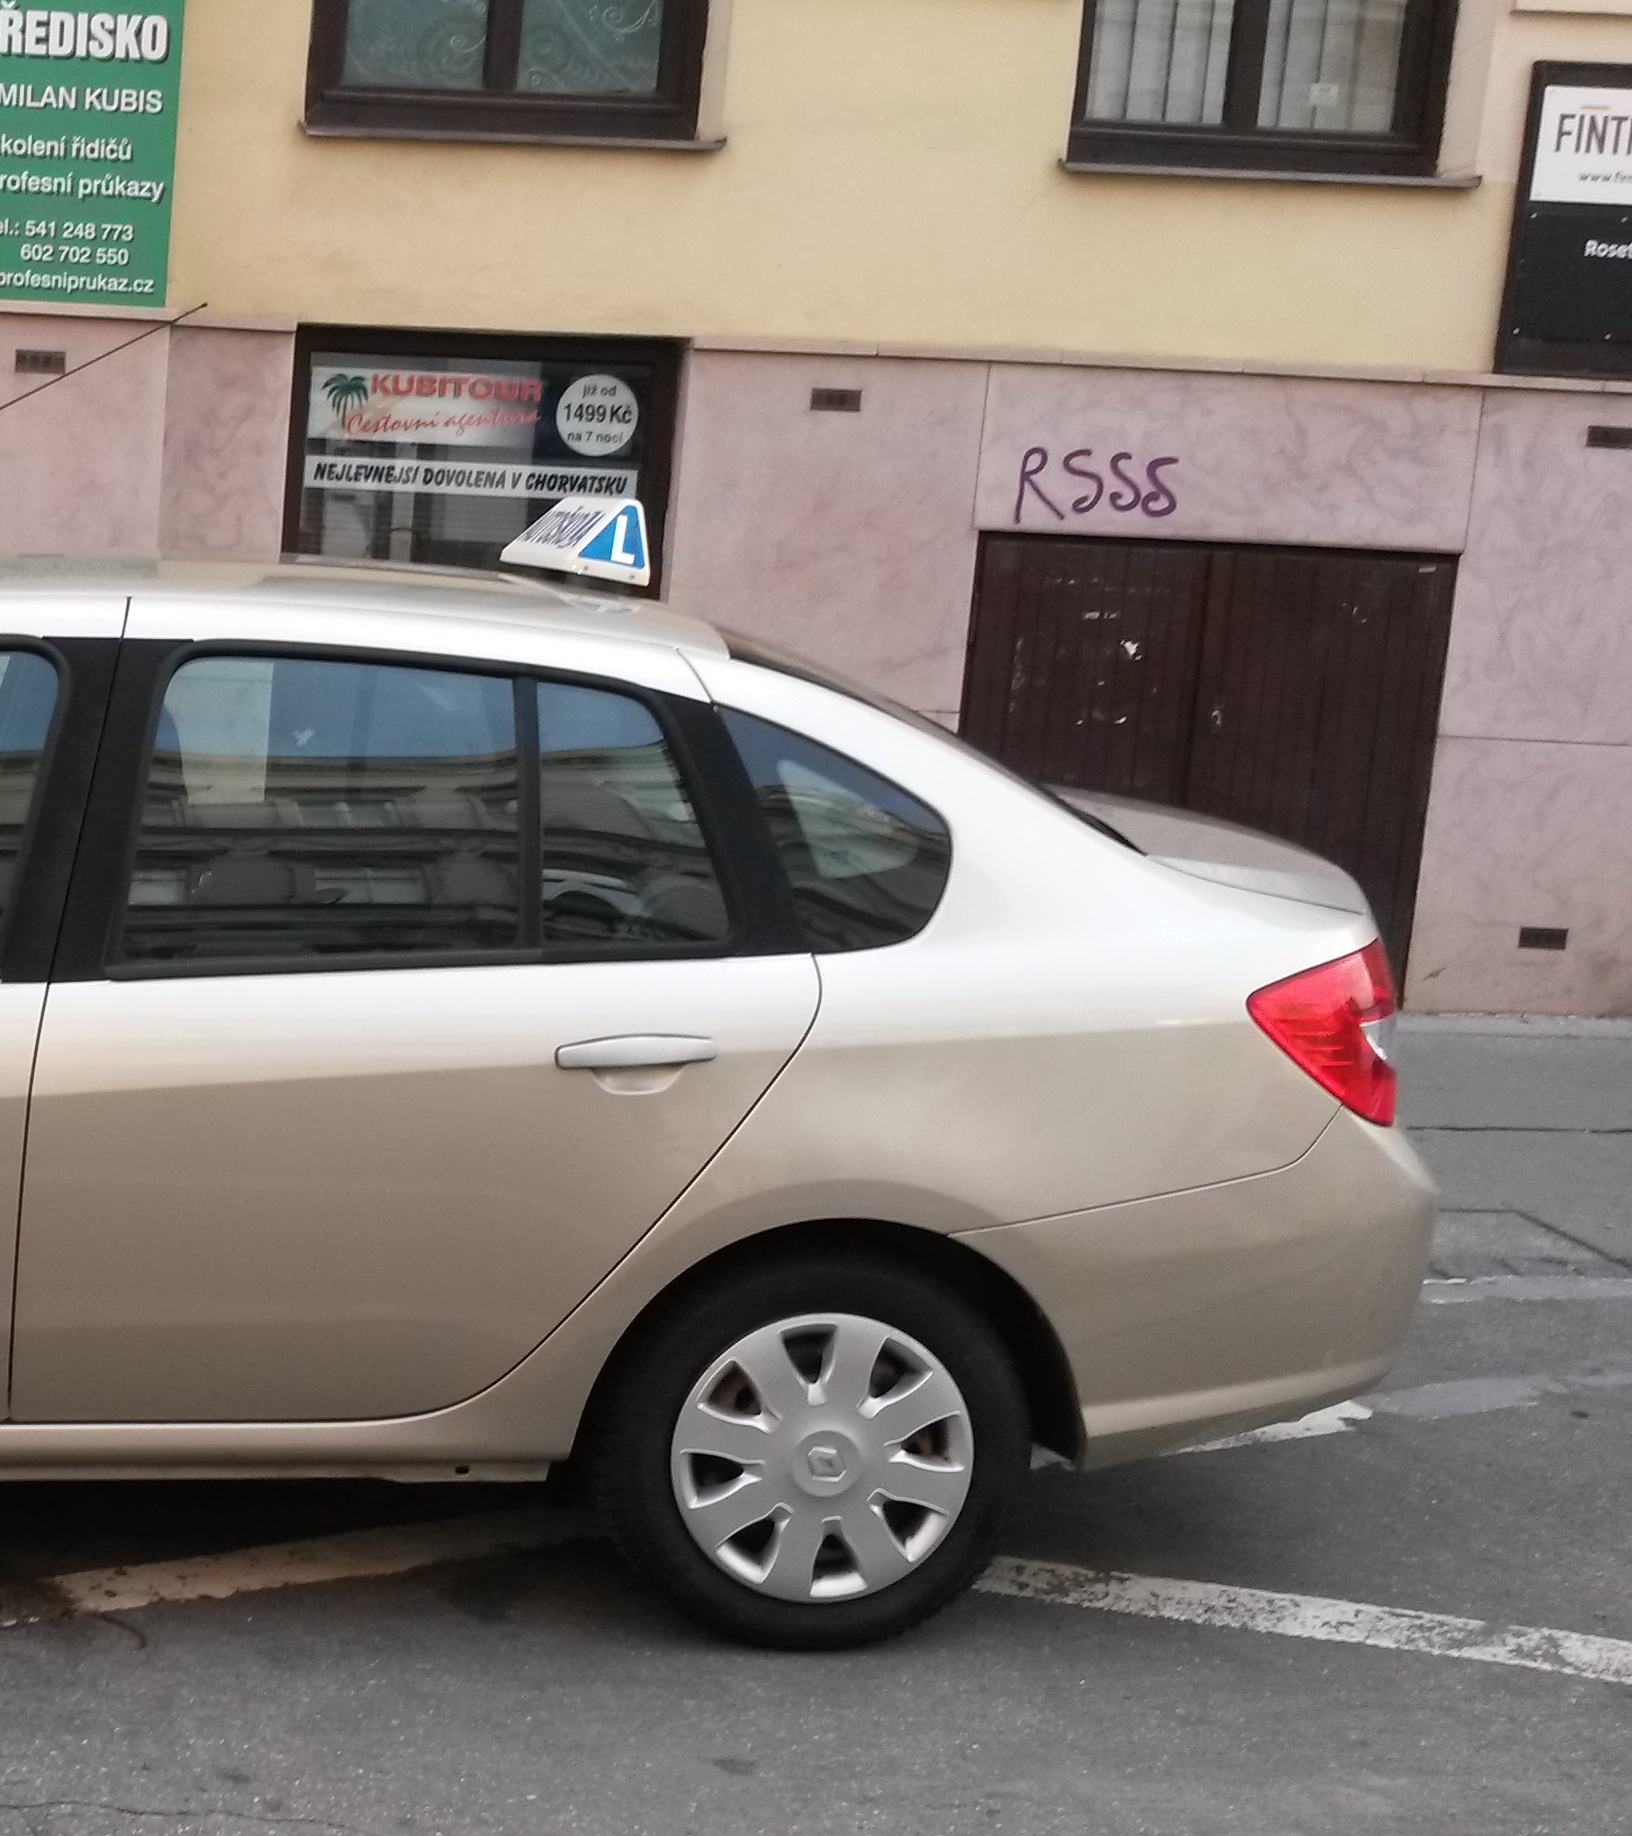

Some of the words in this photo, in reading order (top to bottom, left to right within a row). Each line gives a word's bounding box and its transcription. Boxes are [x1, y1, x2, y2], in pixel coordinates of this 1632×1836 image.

[84, 88, 164, 115] KUBIS
[71, 135, 132, 162] řidičů
[77, 173, 165, 204] průkazy
[24, 219, 58, 238] 541
[62, 221, 97, 242] 248
[101, 224, 136, 243] 773
[20, 242, 55, 262] 602
[58, 245, 92, 264] 702
[95, 247, 131, 266] 550
[370, 373, 543, 401] KUBITOUR
[600, 385, 617, 397] od
[346, 411, 440, 435] Cestovní
[563, 402, 607, 424] 1499
[609, 403, 633, 425] Kč
[585, 431, 593, 442] 7
[510, 471, 523, 491] V
[524, 472, 629, 496] CHORVATSKU
[610, 514, 635, 565] L
